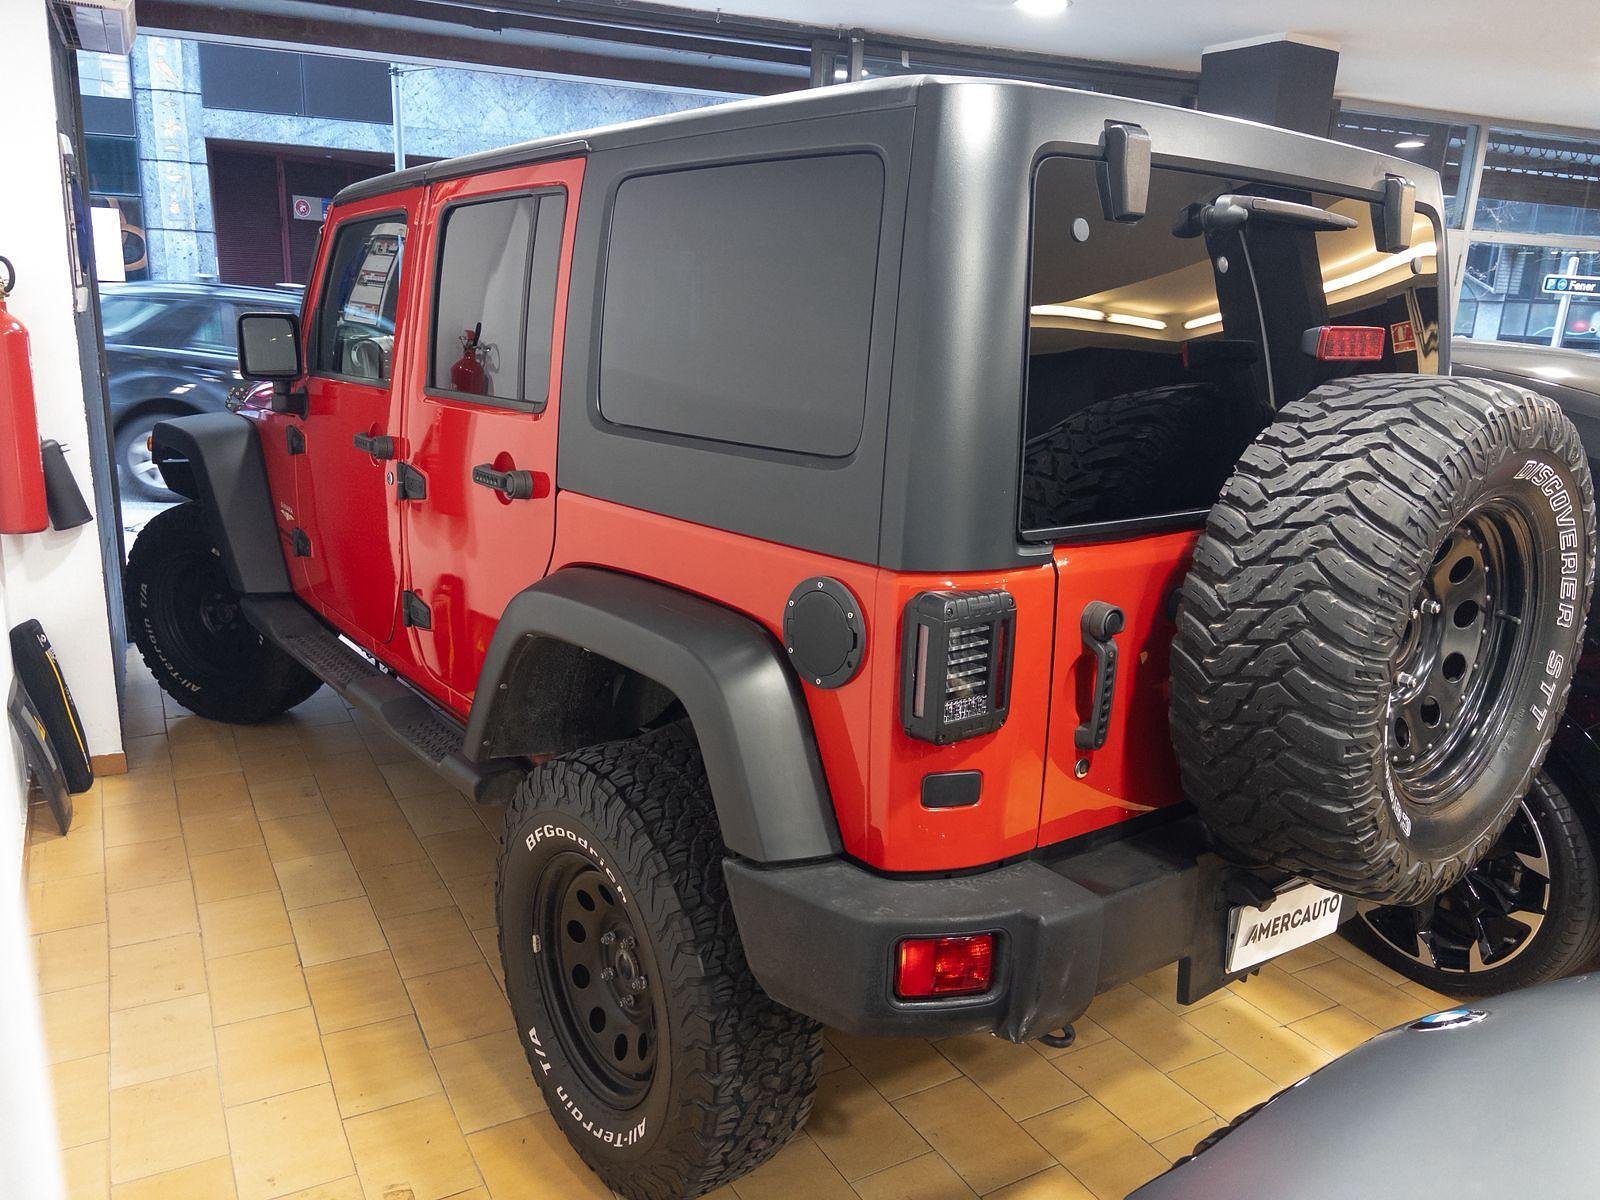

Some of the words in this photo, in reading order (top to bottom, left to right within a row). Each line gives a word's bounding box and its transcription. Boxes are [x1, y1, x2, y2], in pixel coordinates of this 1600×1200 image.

[1569, 280, 1596, 291] Fener
[1512, 459, 1578, 629] DISCOVERER
[1530, 648, 1564, 732] STT
[525, 824, 628, 904] BFGoodrich
[1245, 894, 1340, 946] AMERCAUTO
[528, 1025, 552, 1078] T/A
[556, 1085, 648, 1148] All-Terrain
